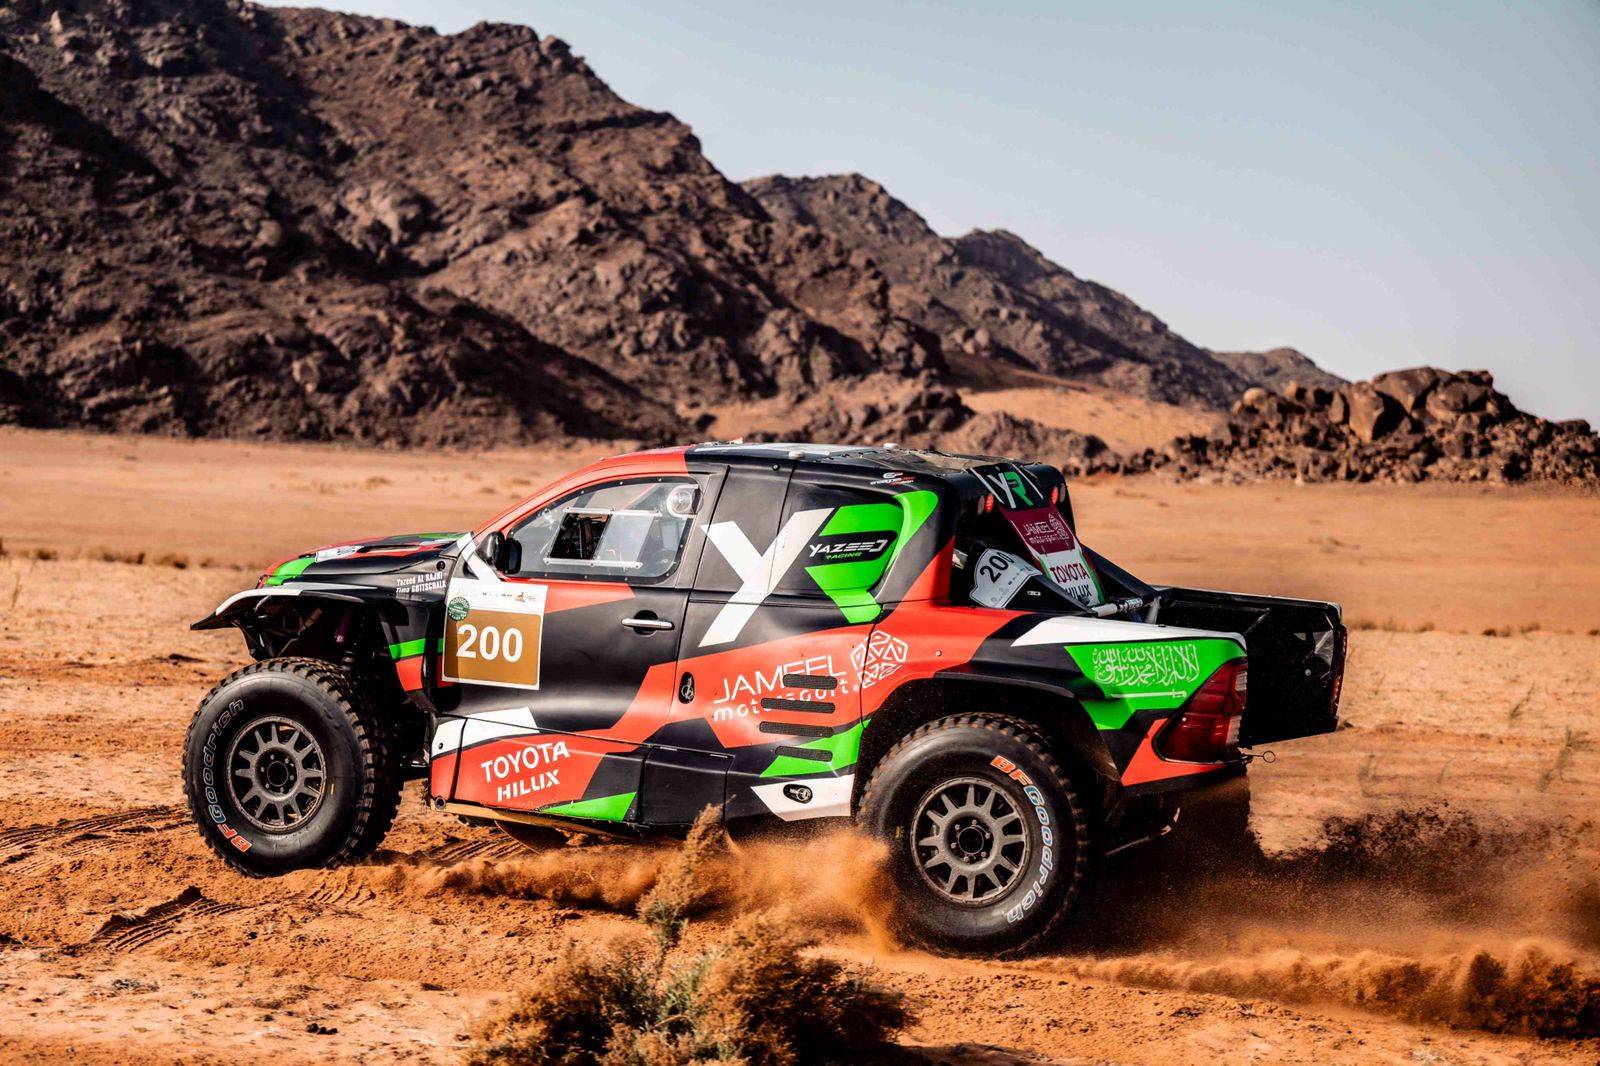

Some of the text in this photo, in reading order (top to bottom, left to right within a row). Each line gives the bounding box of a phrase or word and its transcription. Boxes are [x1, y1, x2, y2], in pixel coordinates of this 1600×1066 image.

[809, 539, 888, 557] YAZEED
[397, 576, 416, 586] Yazeed
[417, 574, 424, 583] AL
[1049, 562, 1090, 583] TOYOTA
[456, 624, 523, 662] 200
[203, 699, 252, 852] BFGoodrich
[481, 741, 570, 783] TOYOTA
[497, 769, 560, 801] HILUX
[990, 755, 1053, 923] BFGoodrich
